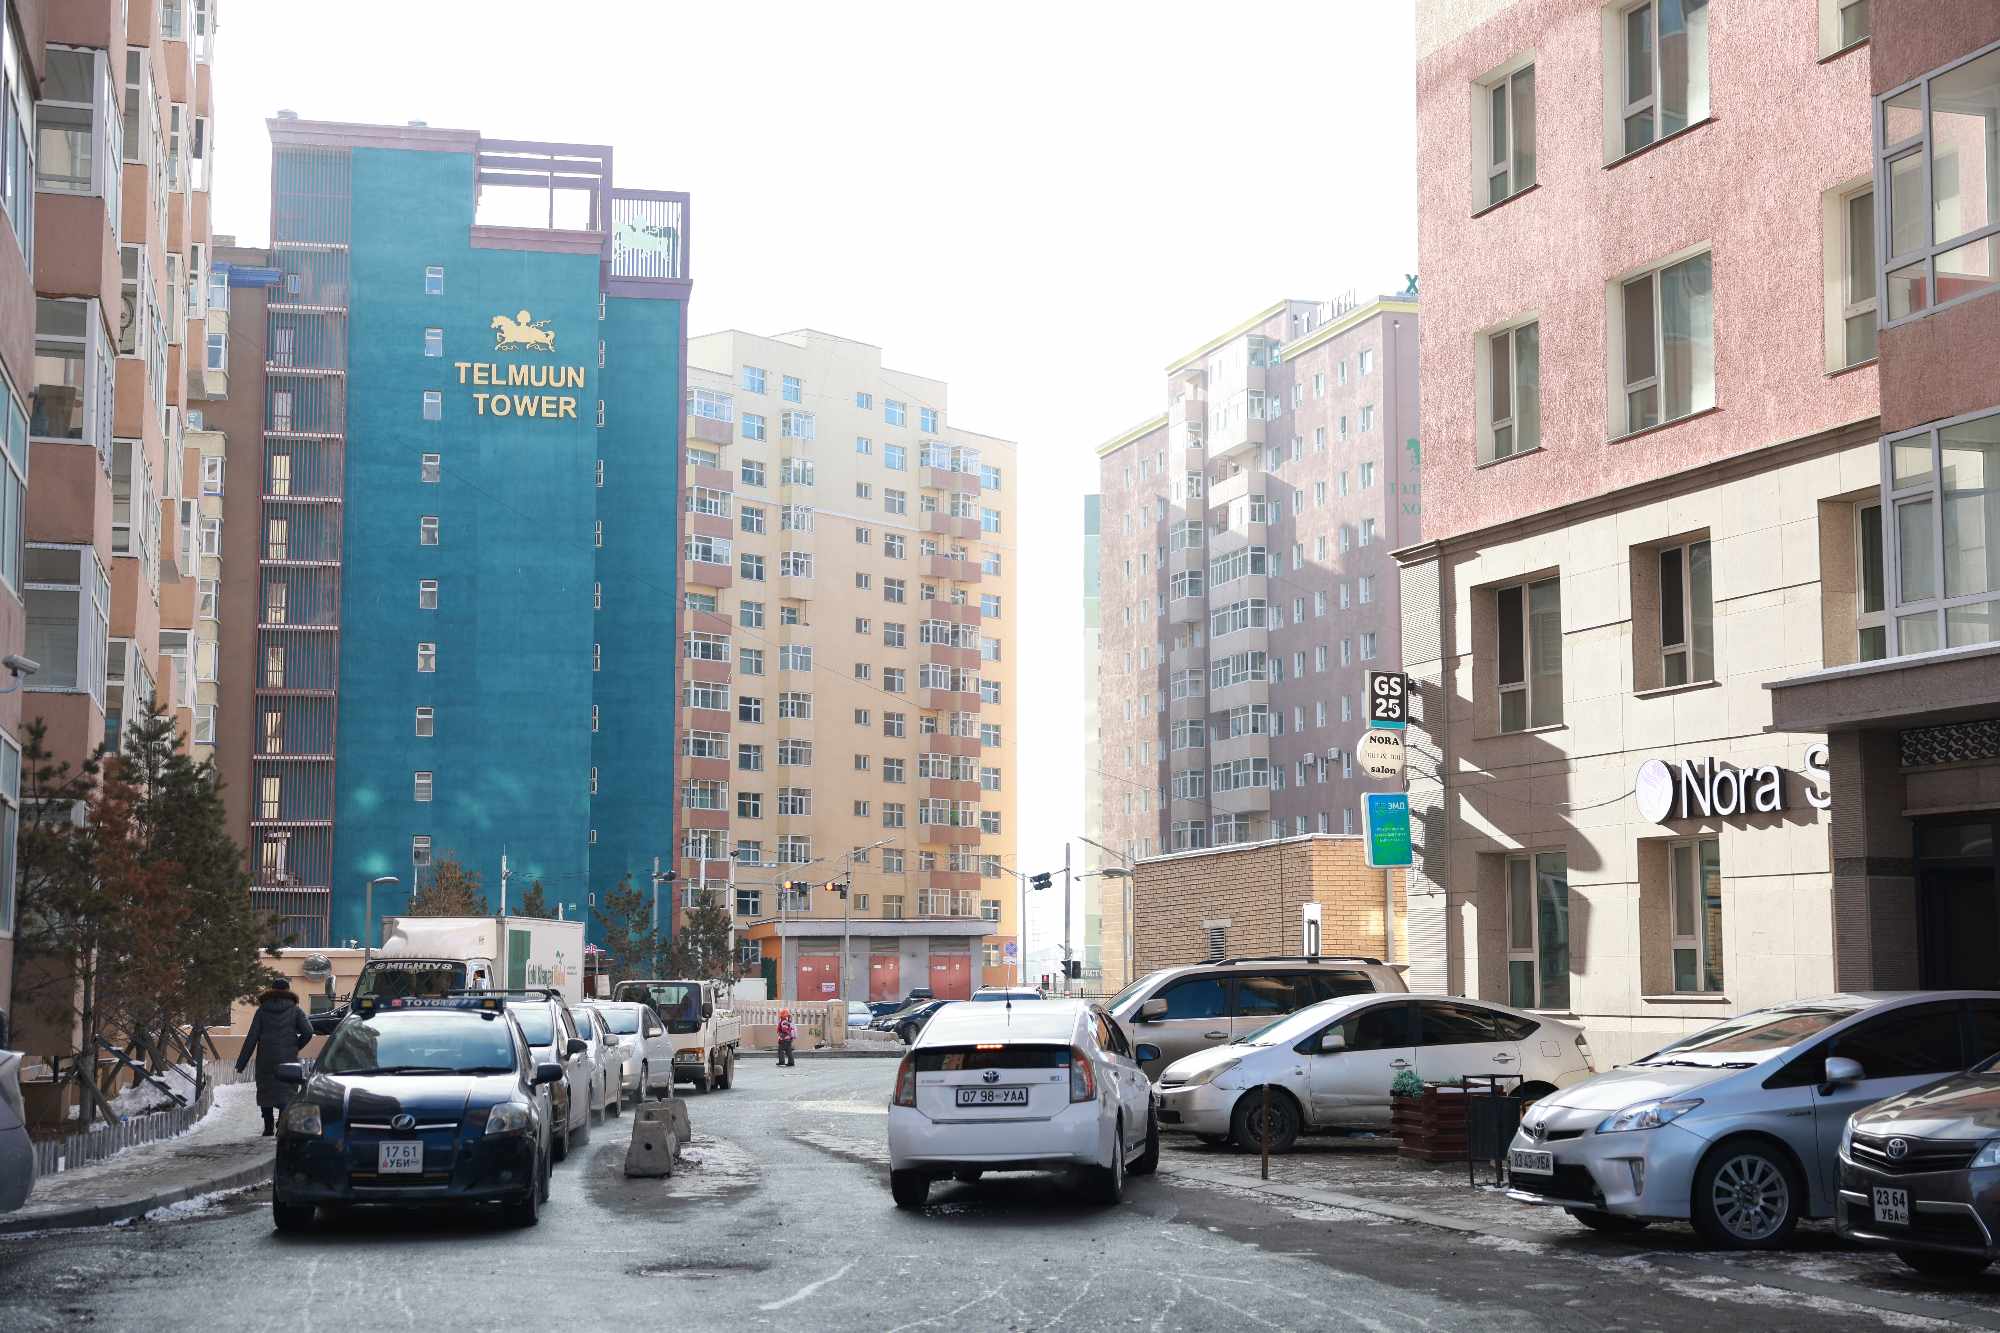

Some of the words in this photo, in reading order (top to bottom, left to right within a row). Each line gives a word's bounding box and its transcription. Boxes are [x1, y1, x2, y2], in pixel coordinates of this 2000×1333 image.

[455, 362, 585, 388] TELMUUN
[473, 393, 577, 418] TOWER
[1374, 676, 1402, 697] GS
[1375, 698, 1401, 719] 25
[1369, 735, 1400, 746] NORA
[1370, 765, 1396, 775] salon
[1681, 756, 1782, 819] Nora
[386, 962, 441, 970] MIGHTY
